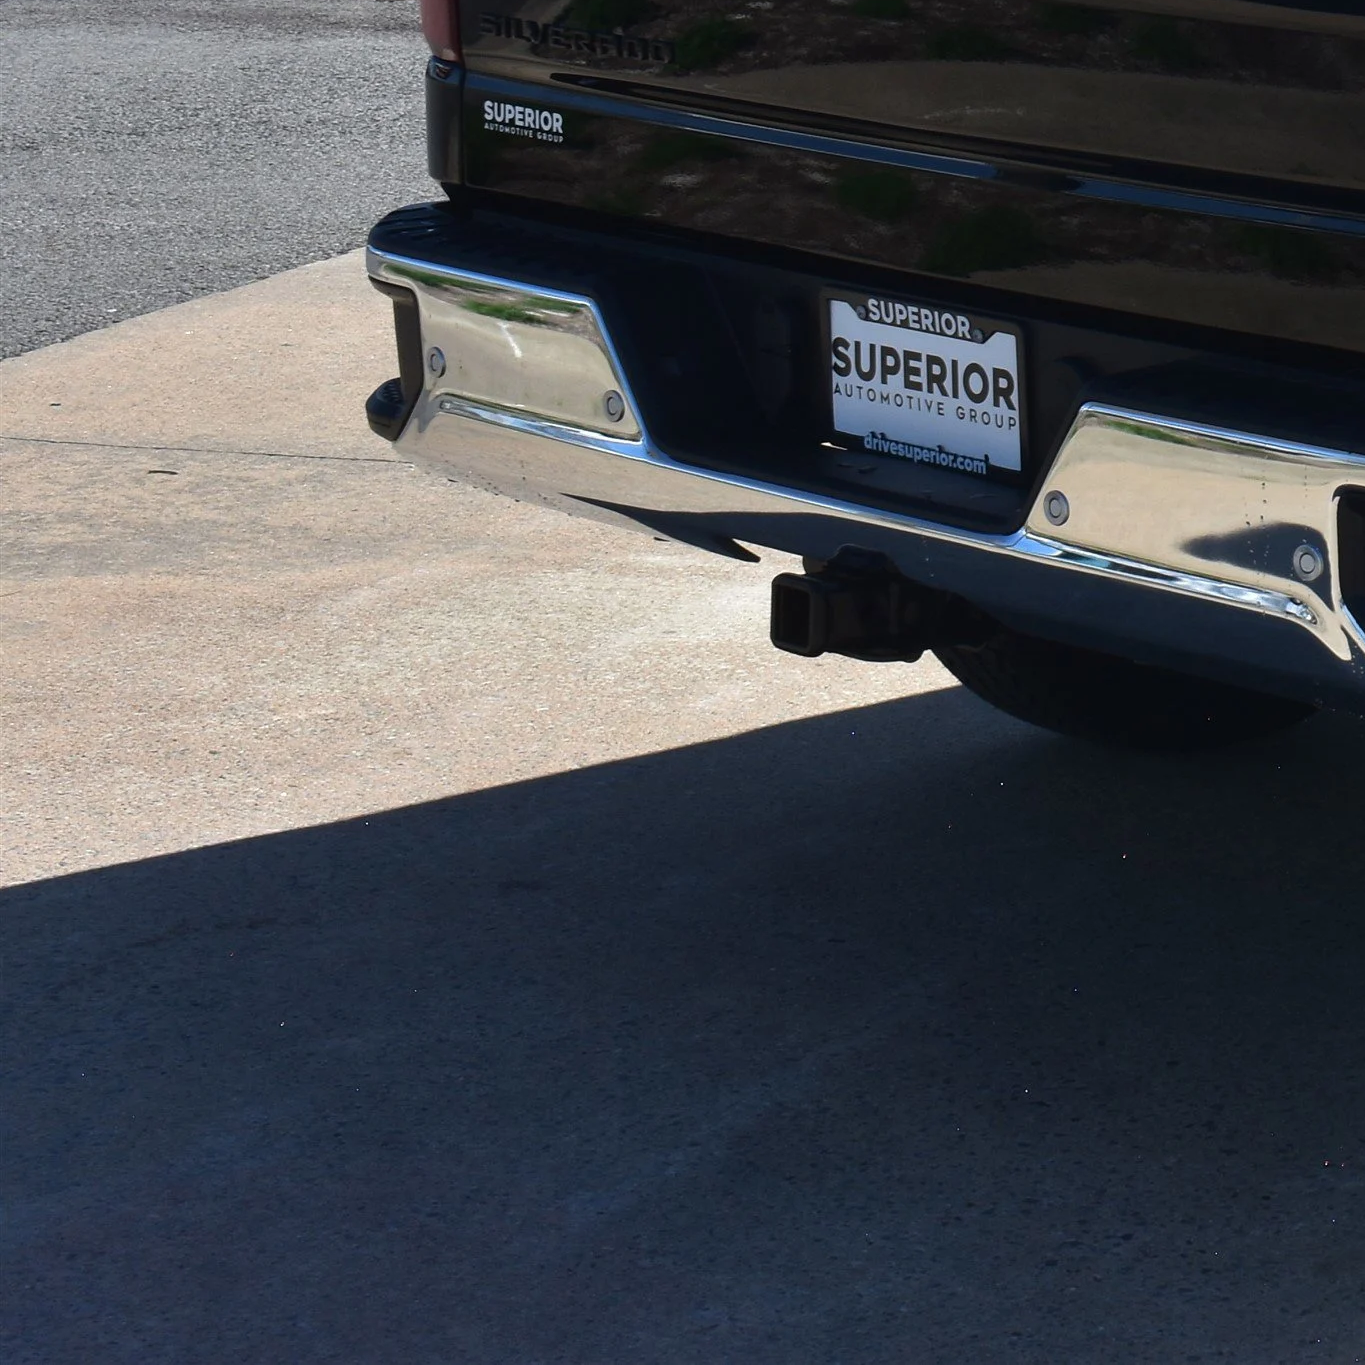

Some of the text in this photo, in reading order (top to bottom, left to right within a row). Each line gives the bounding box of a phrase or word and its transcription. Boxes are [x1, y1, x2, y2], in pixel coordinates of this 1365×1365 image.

[479, 11, 676, 64] SILVERADO
[483, 100, 564, 134] SUPERIOR
[484, 122, 564, 144] AUTOMOTIVE GROUP
[867, 298, 973, 339] SUPERIOR
[832, 337, 1017, 411] SUPERIOR
[834, 383, 1017, 431] AUTOMOTIVE GROUP
[864, 432, 988, 475] drivesuperior.com
